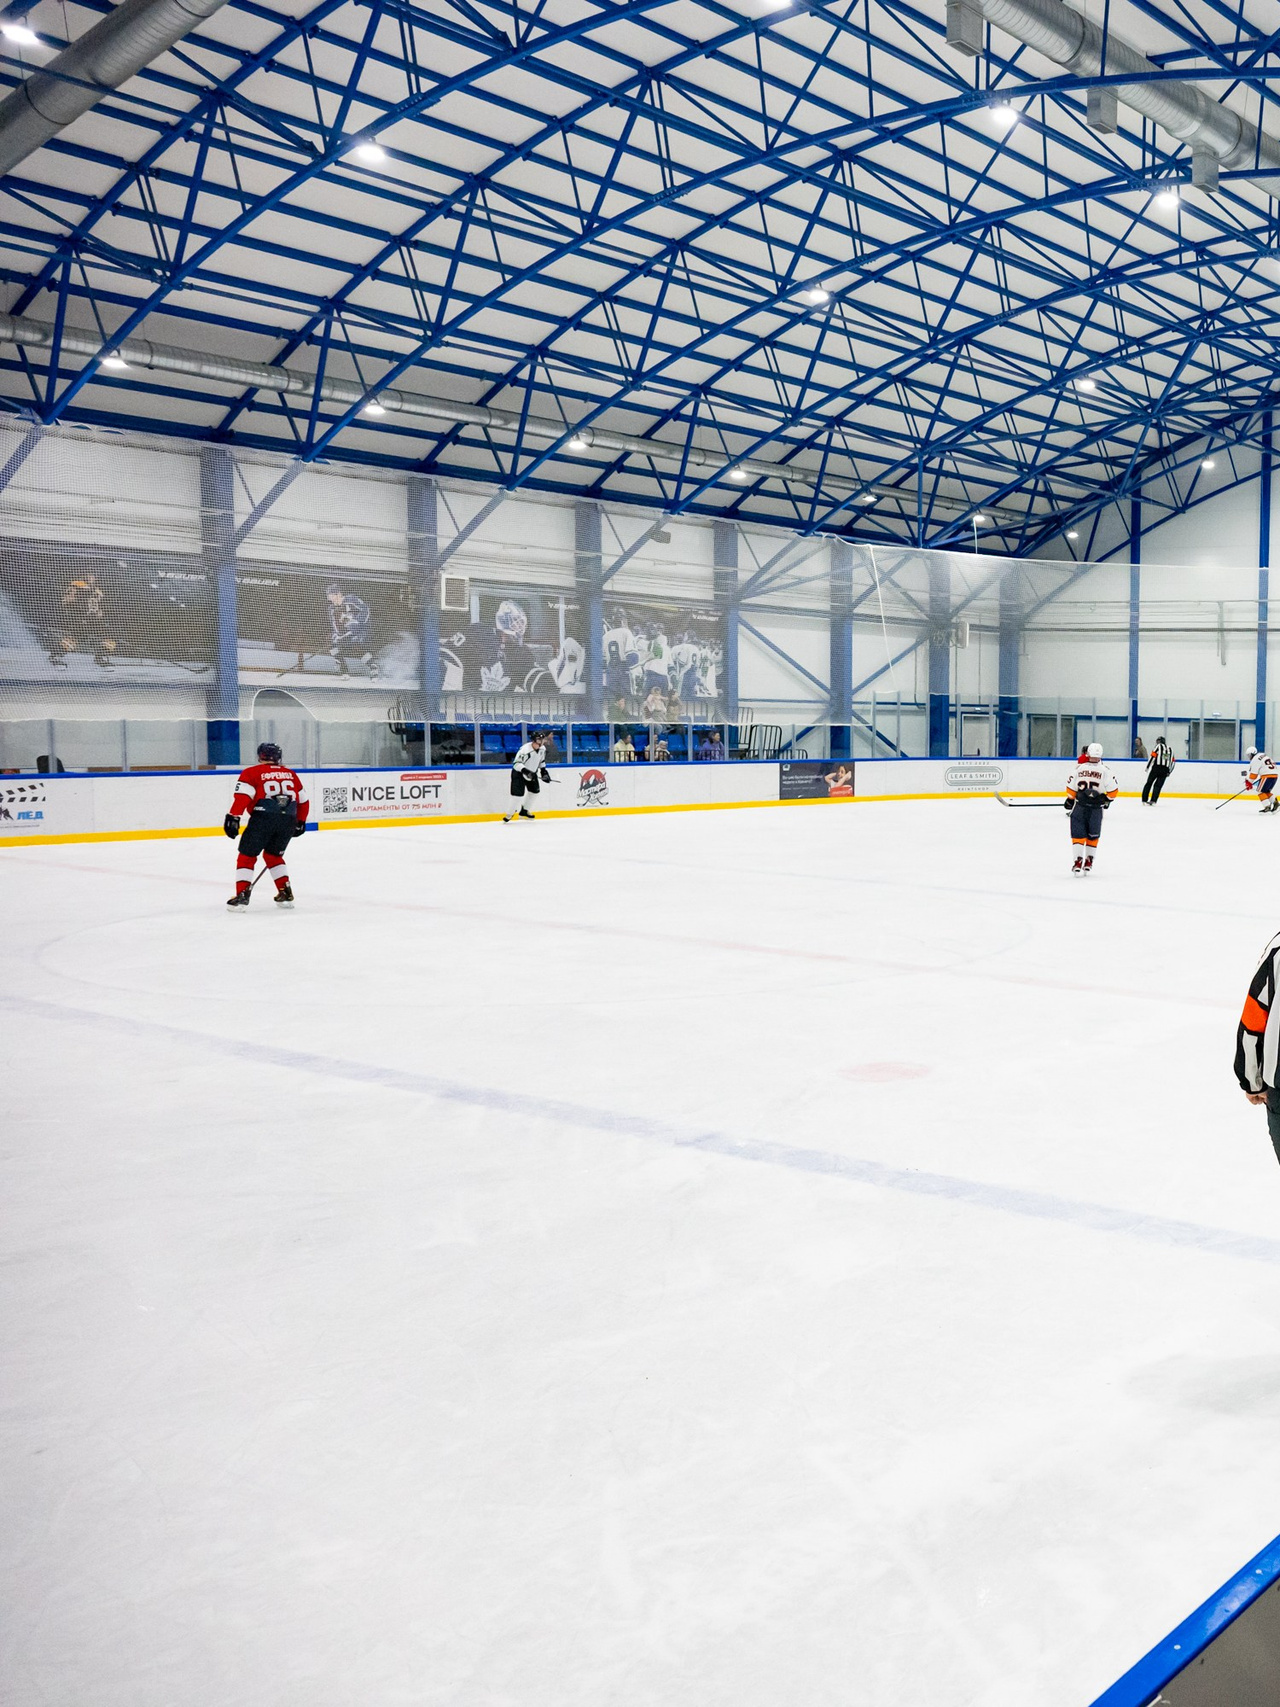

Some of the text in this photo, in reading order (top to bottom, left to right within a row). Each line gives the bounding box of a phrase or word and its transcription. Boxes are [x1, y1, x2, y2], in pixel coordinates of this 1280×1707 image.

[263, 780, 297, 802] 86
[401, 784, 442, 800] LOFT
[352, 804, 400, 812] АПАРТАМЕНТЫ
